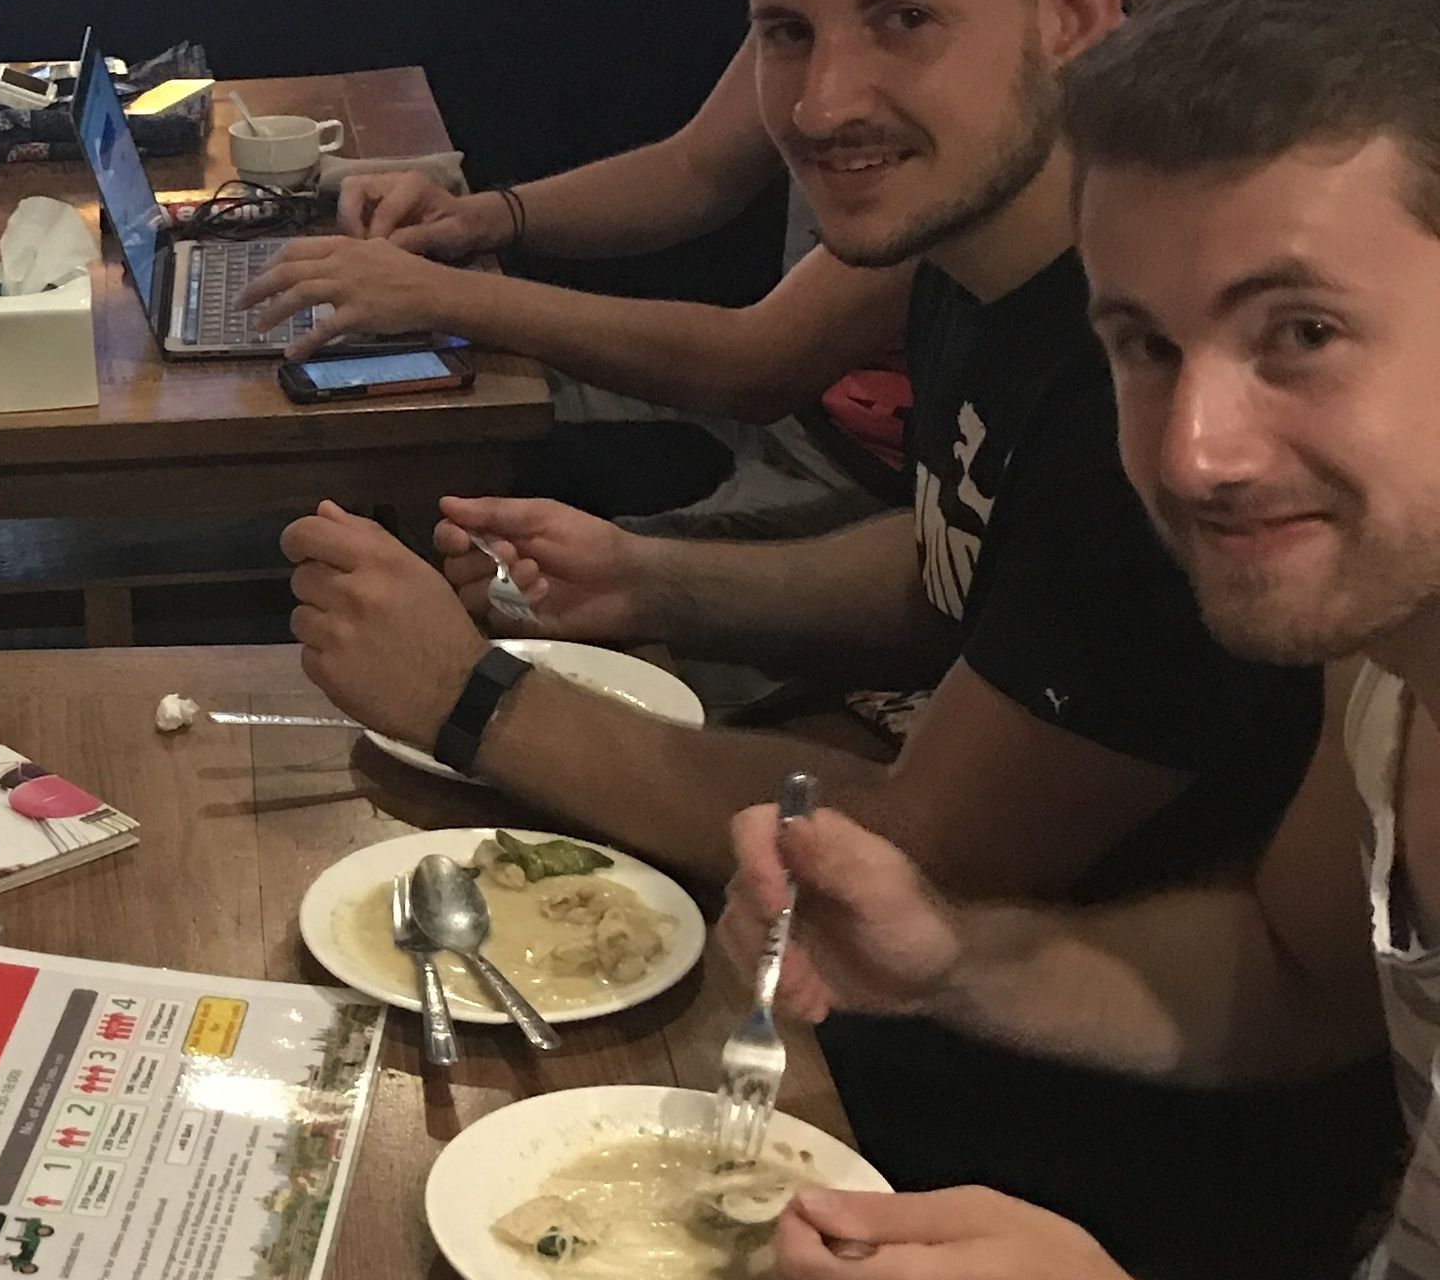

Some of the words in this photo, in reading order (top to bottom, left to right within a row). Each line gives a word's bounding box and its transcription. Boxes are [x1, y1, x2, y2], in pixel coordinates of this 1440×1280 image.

[111, 998, 137, 1010] 4
[88, 1050, 117, 1062] 3
[66, 1103, 95, 1116] 2
